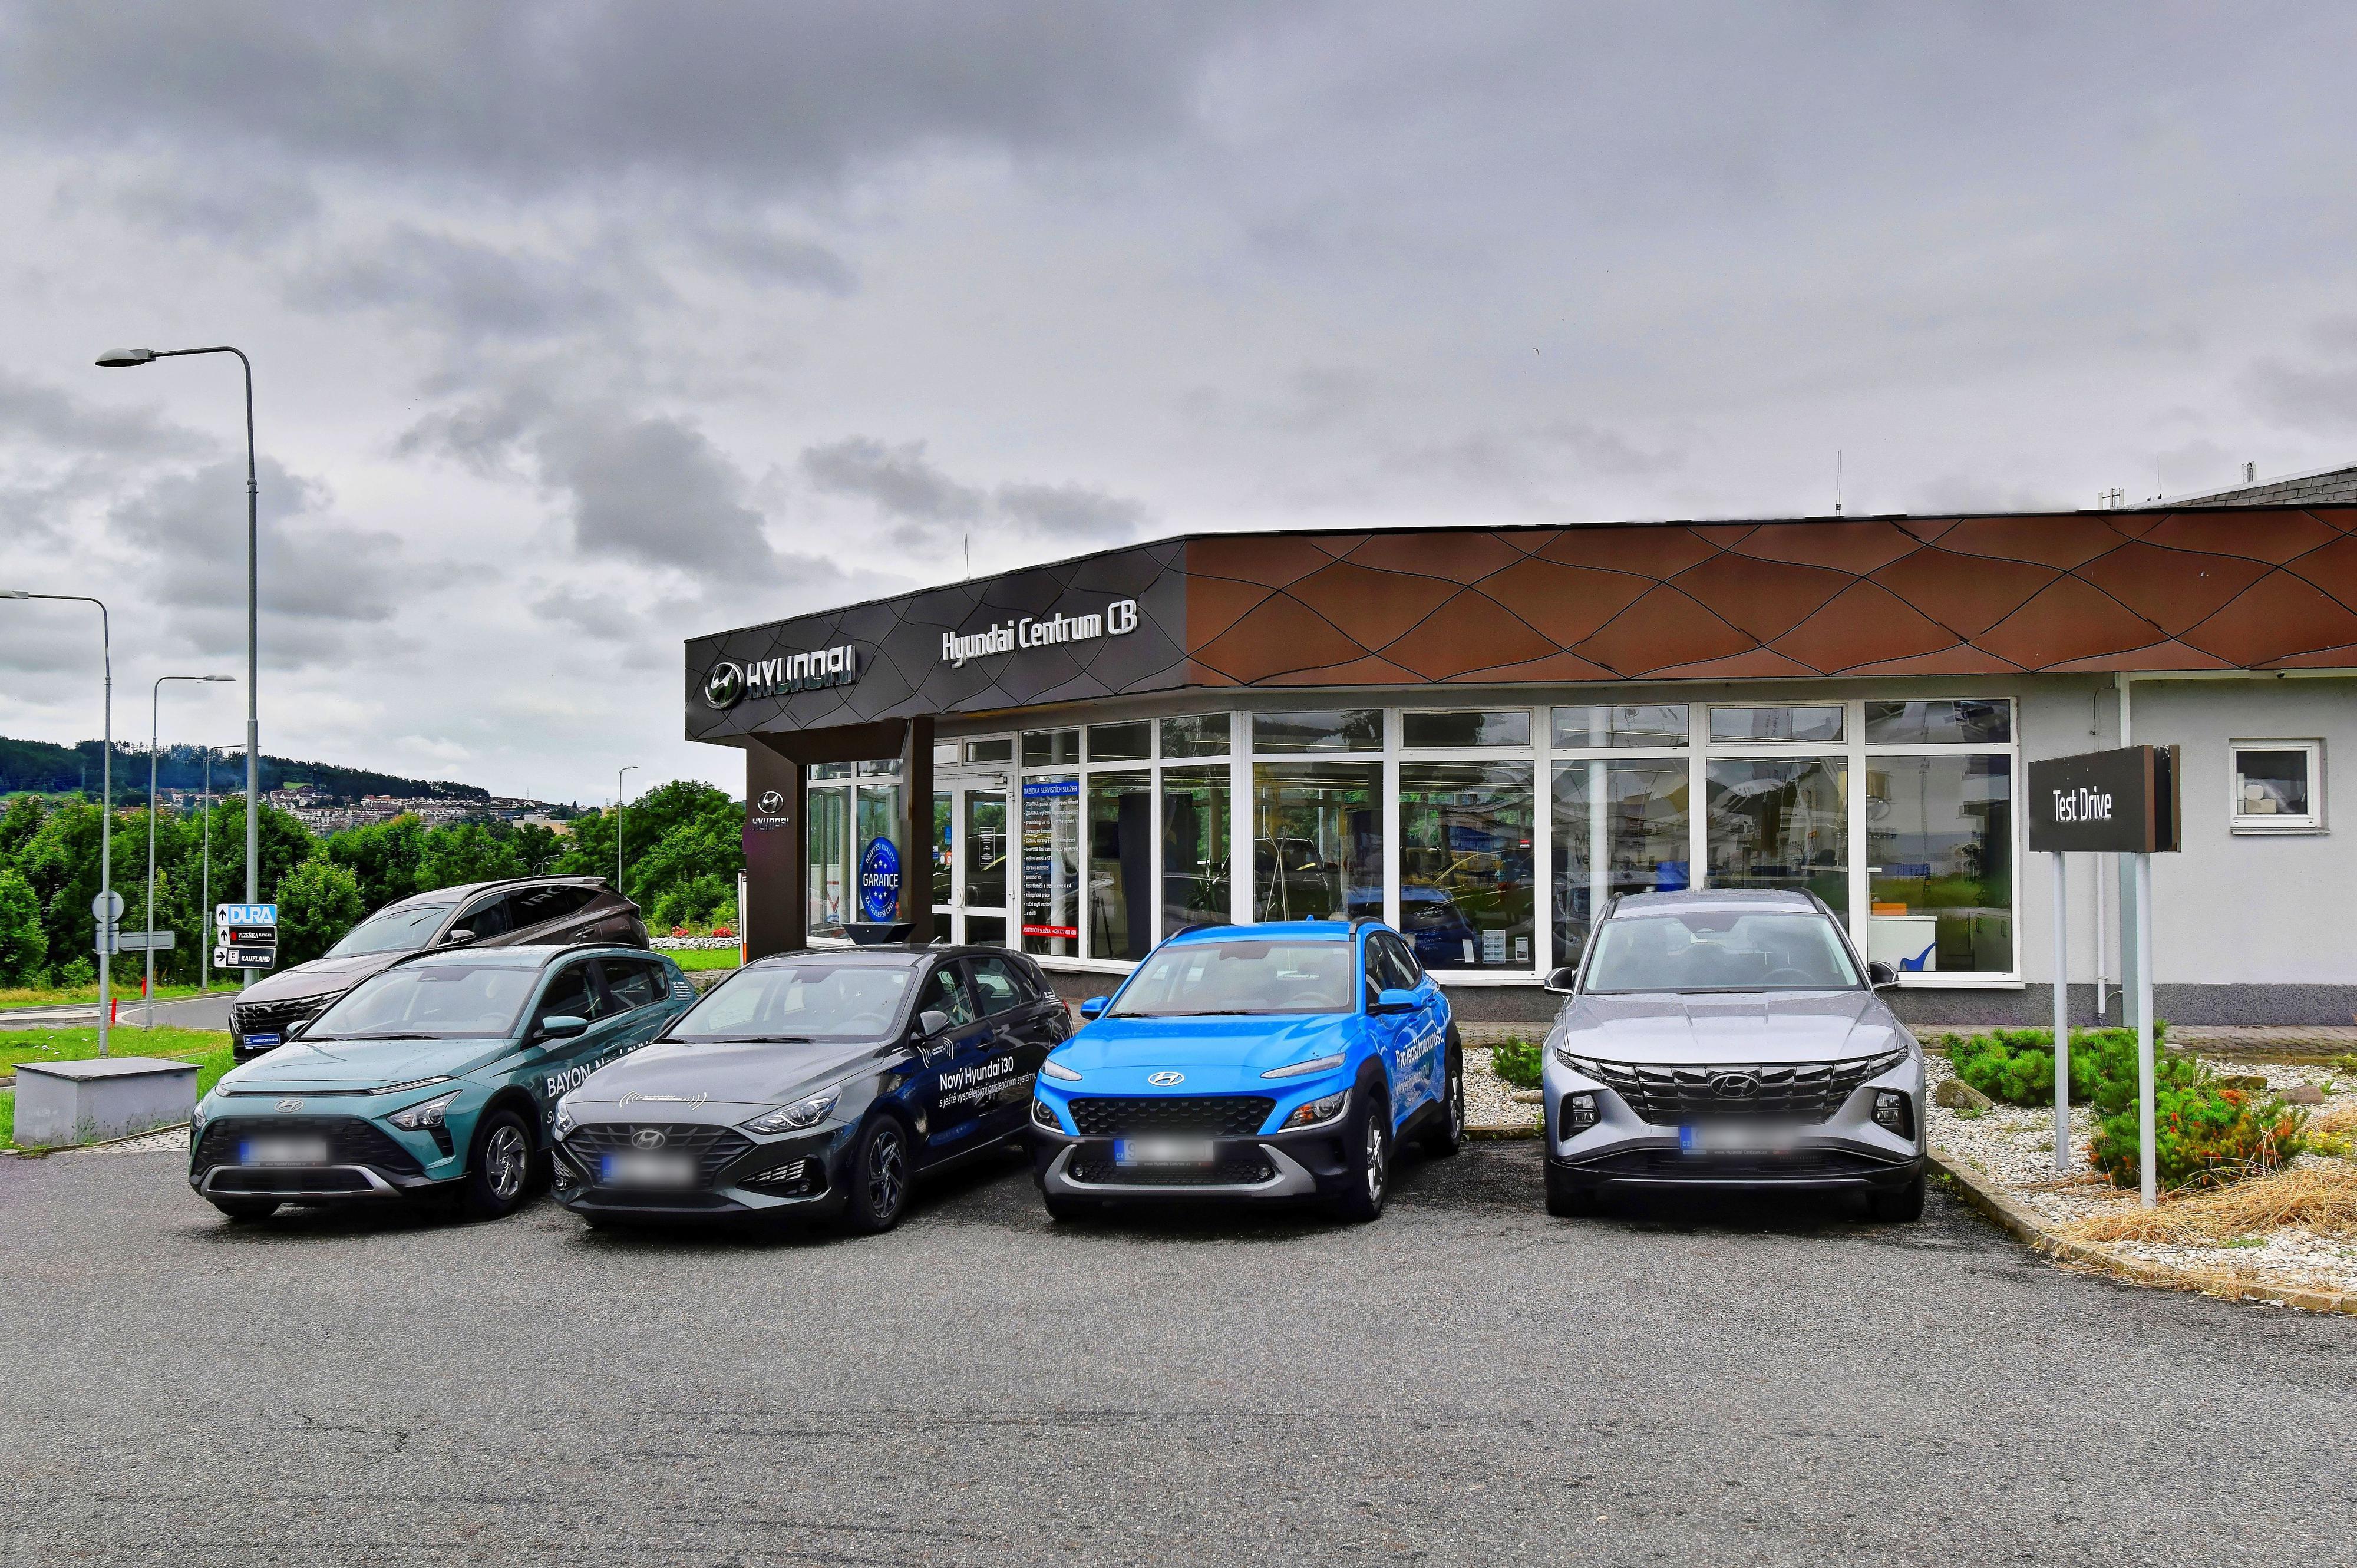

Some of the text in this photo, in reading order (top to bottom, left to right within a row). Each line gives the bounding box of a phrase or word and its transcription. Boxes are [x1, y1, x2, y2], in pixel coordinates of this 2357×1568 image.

[943, 599, 1138, 669] Hyundai Centrum CB
[747, 645, 855, 699] HYUNDAI
[2052, 785, 2112, 821] Test Drive
[752, 817, 789, 828] HYUNDAI
[882, 843, 896, 863] KVALITY
[863, 873, 899, 887] GARANCE
[230, 906, 274, 923] DURA
[865, 896, 870, 905] ZA
[939, 1055, 1014, 1091] Nový Hyundai i30
[1395, 1049, 1407, 1071] Pro
[547, 1063, 590, 1098] BAYON
[943, 1093, 956, 1109] ještě
[1017, 1071, 1036, 1087] systémy.
